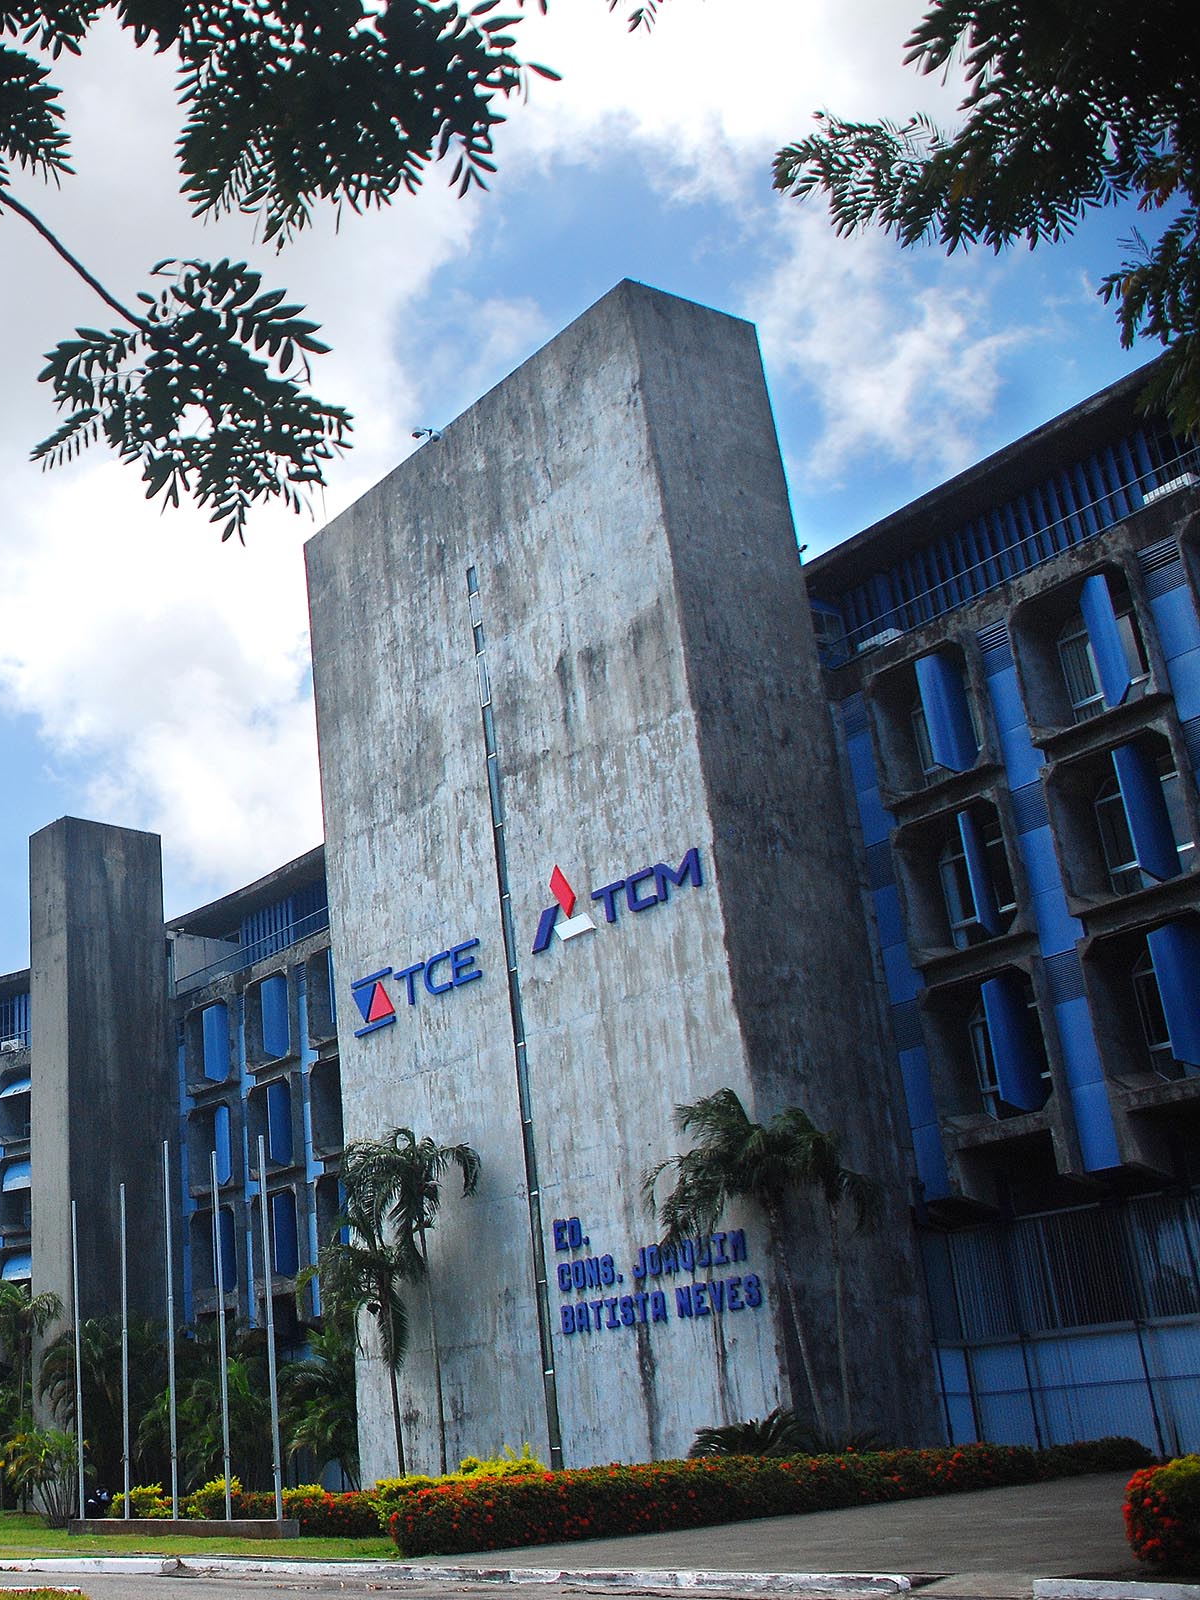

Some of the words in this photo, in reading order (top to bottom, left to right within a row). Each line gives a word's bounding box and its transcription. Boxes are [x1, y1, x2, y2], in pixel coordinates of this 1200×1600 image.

[591, 847, 703, 923] TCM
[393, 938, 482, 1005] TCE
[553, 1217, 589, 1250] ED.
[557, 1254, 623, 1291] CONS.
[560, 1290, 667, 1334] BATISTA
[675, 1273, 762, 1318] NEVES
